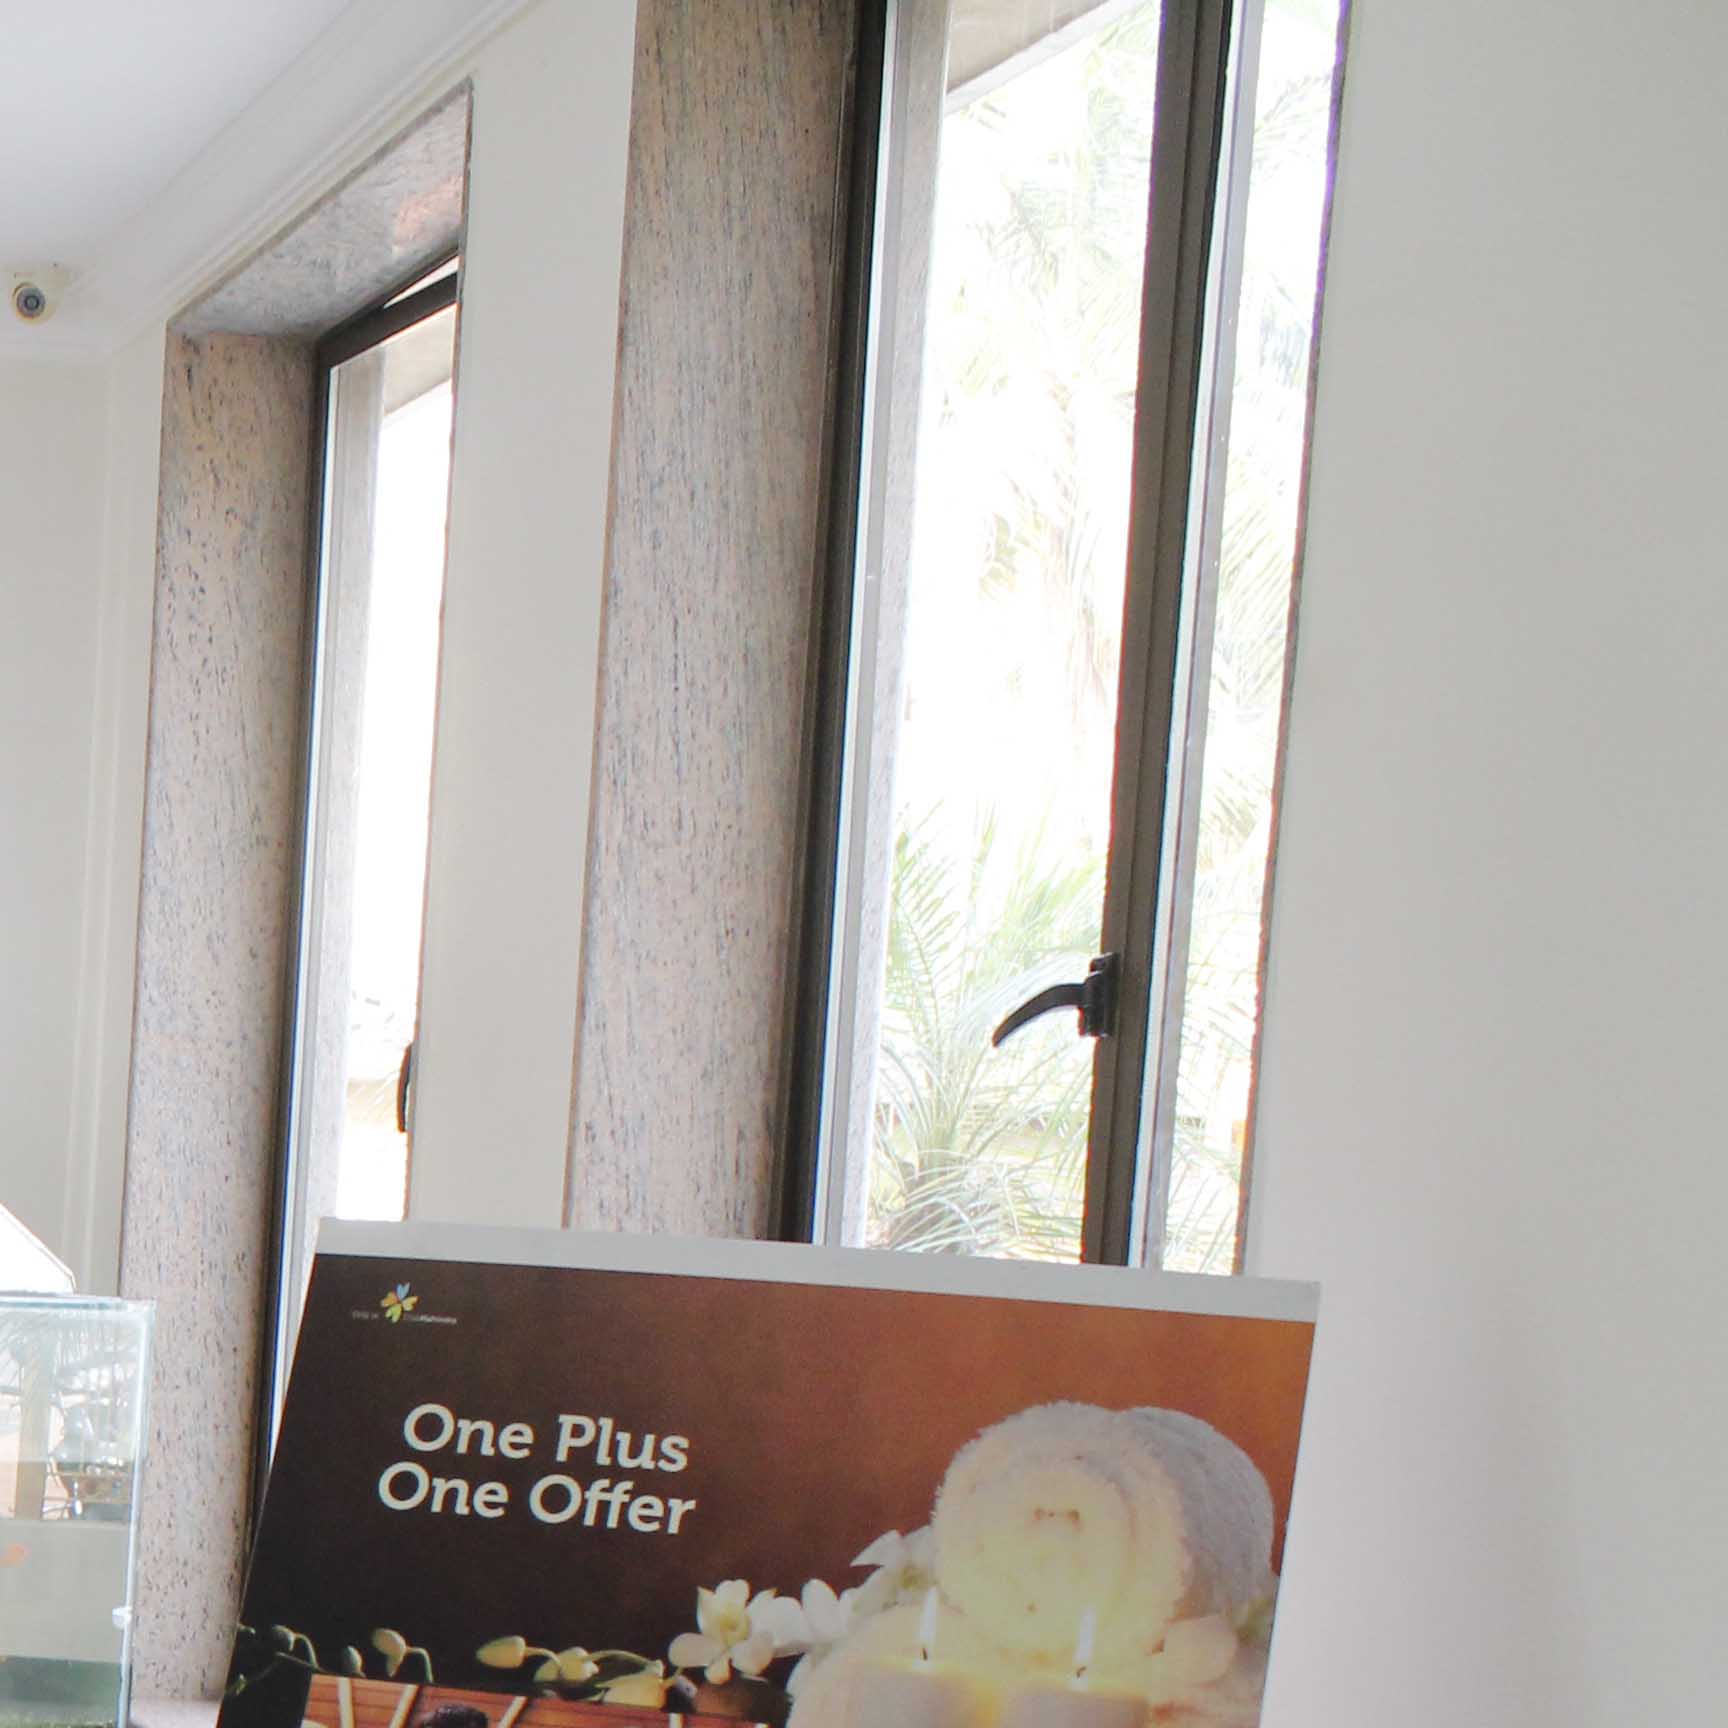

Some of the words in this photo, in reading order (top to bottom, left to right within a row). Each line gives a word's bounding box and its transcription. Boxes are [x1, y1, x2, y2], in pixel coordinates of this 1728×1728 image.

[404, 1404, 533, 1458] One
[557, 1415, 688, 1472] Plus
[379, 1462, 508, 1518] One
[530, 1475, 696, 1533] Offer
